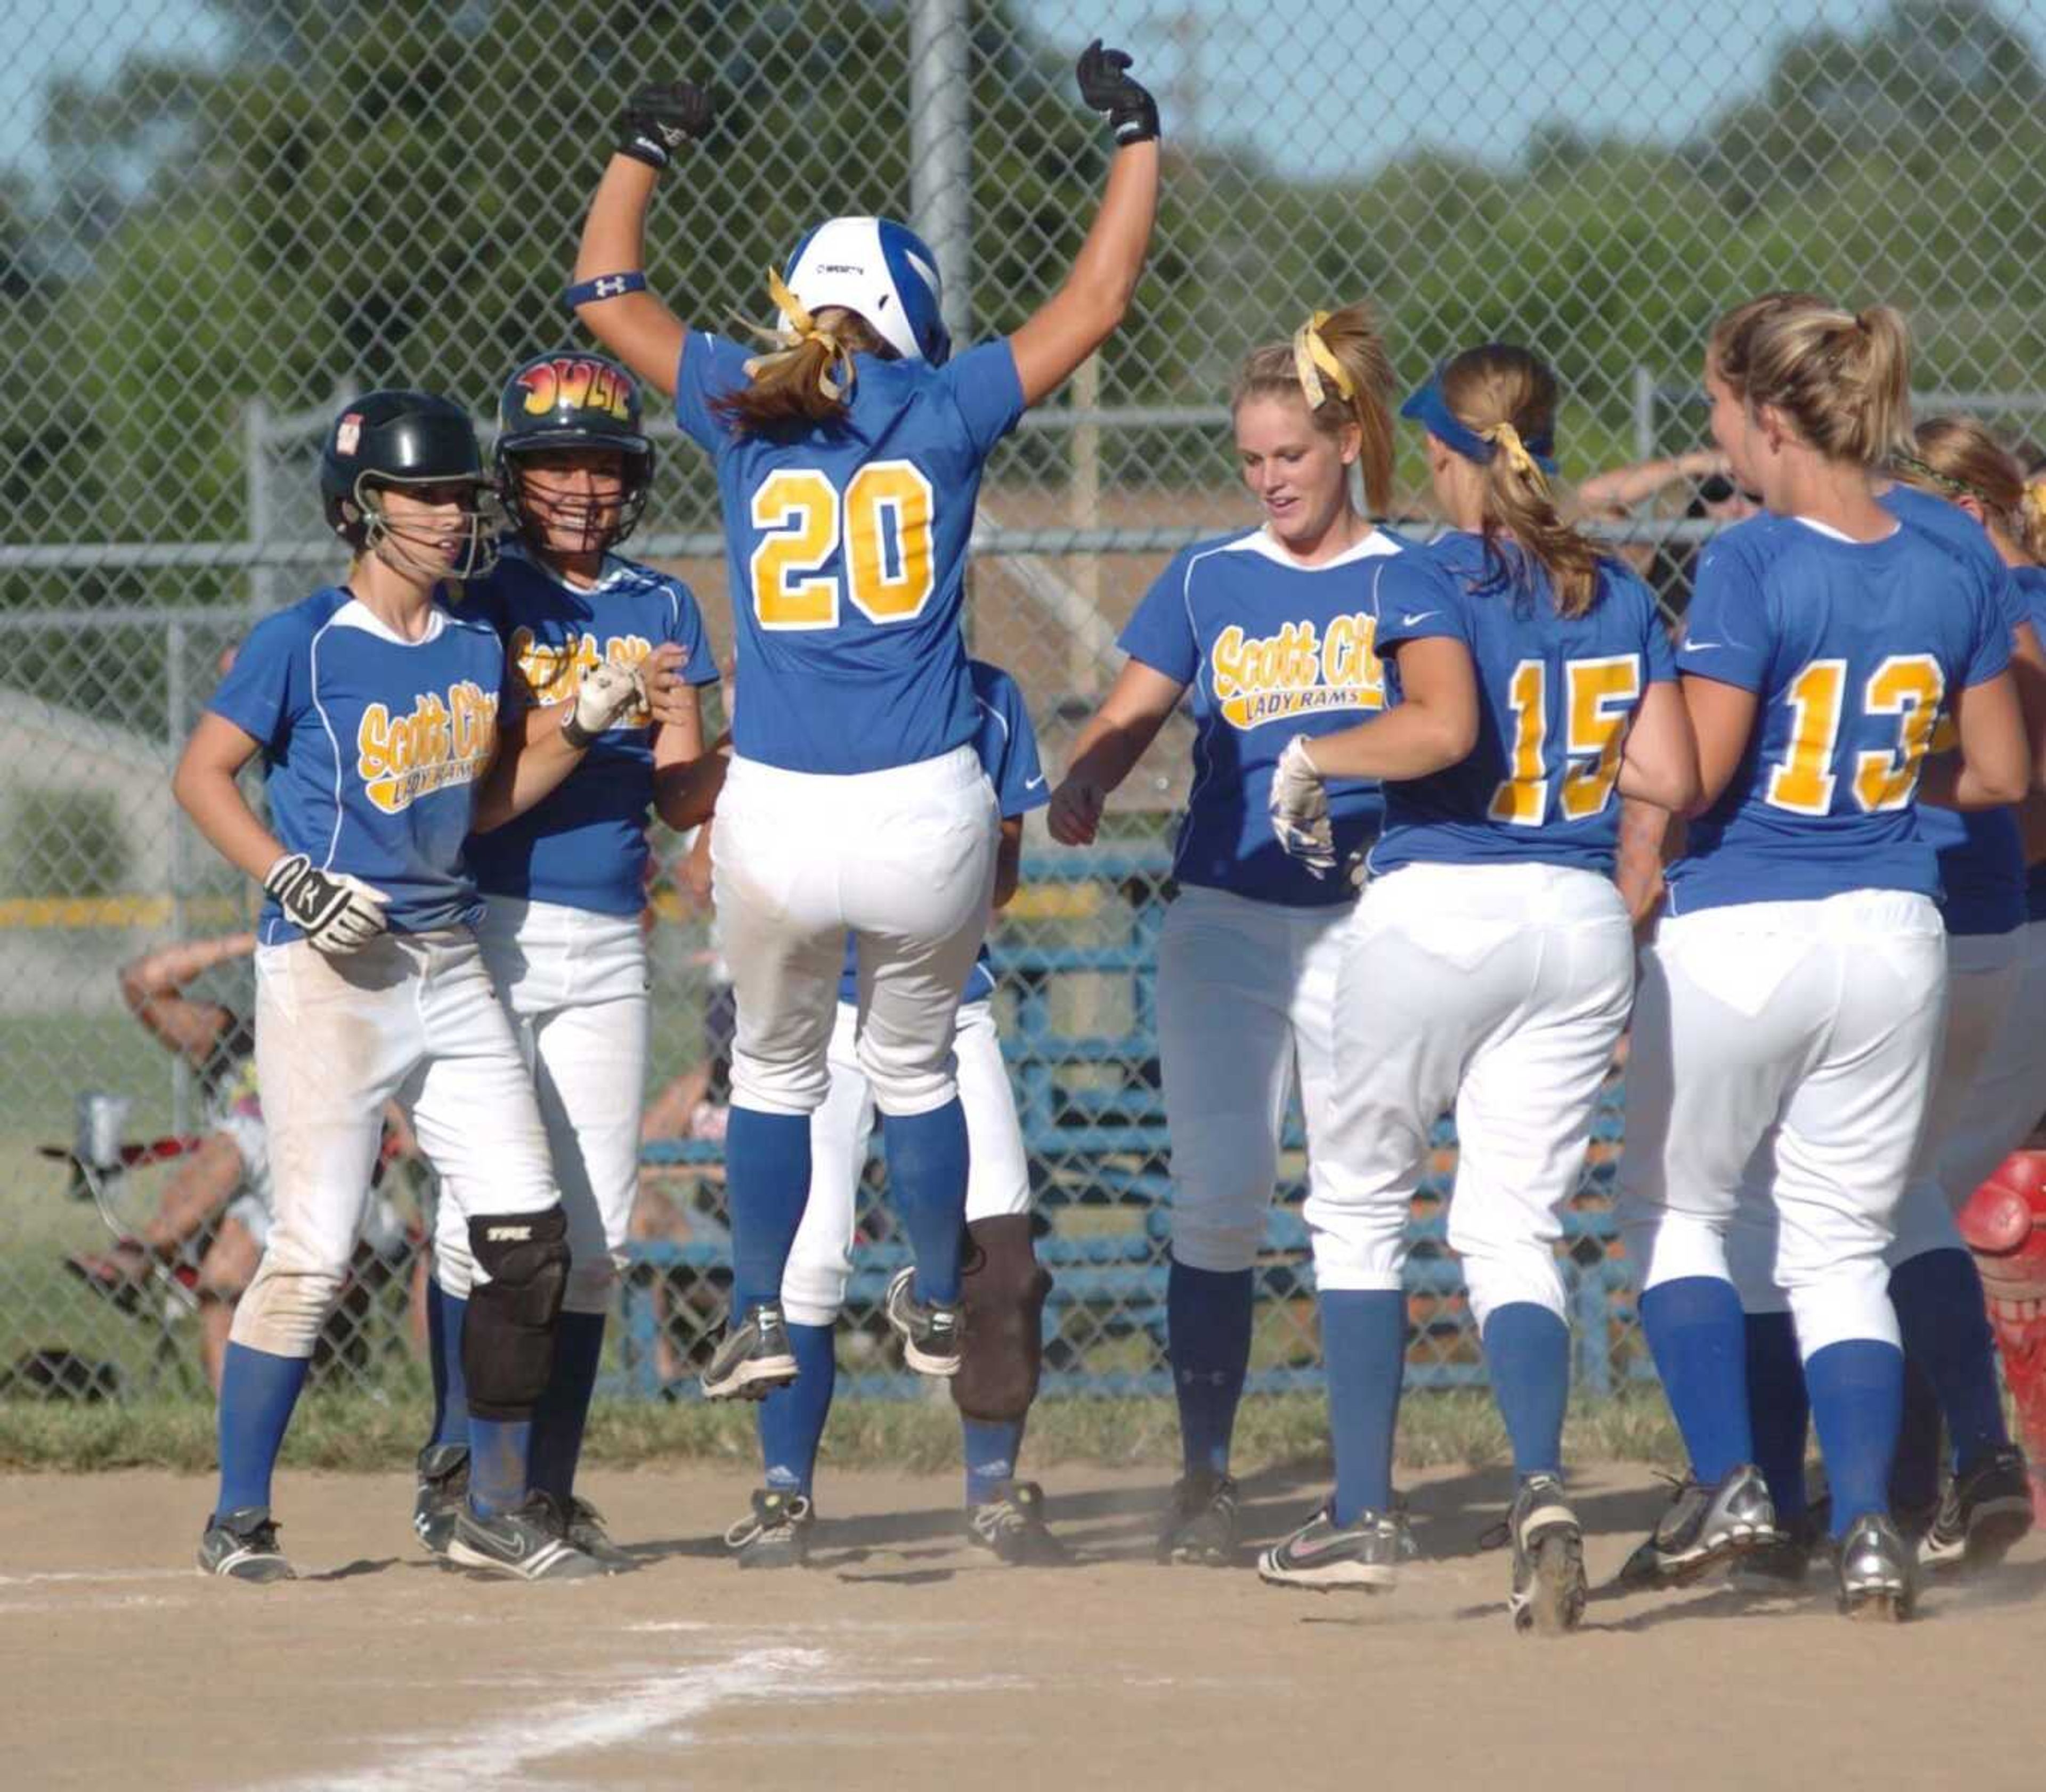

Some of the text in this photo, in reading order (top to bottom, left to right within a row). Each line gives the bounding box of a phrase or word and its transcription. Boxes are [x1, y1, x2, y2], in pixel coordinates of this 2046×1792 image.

[750, 459, 935, 631] 20
[1212, 611, 1384, 699] Scott Cit
[1246, 690, 1358, 720] LADY RAMS
[358, 692, 452, 781] Scott
[1487, 653, 1640, 827] 15
[1765, 653, 1946, 816] 13
